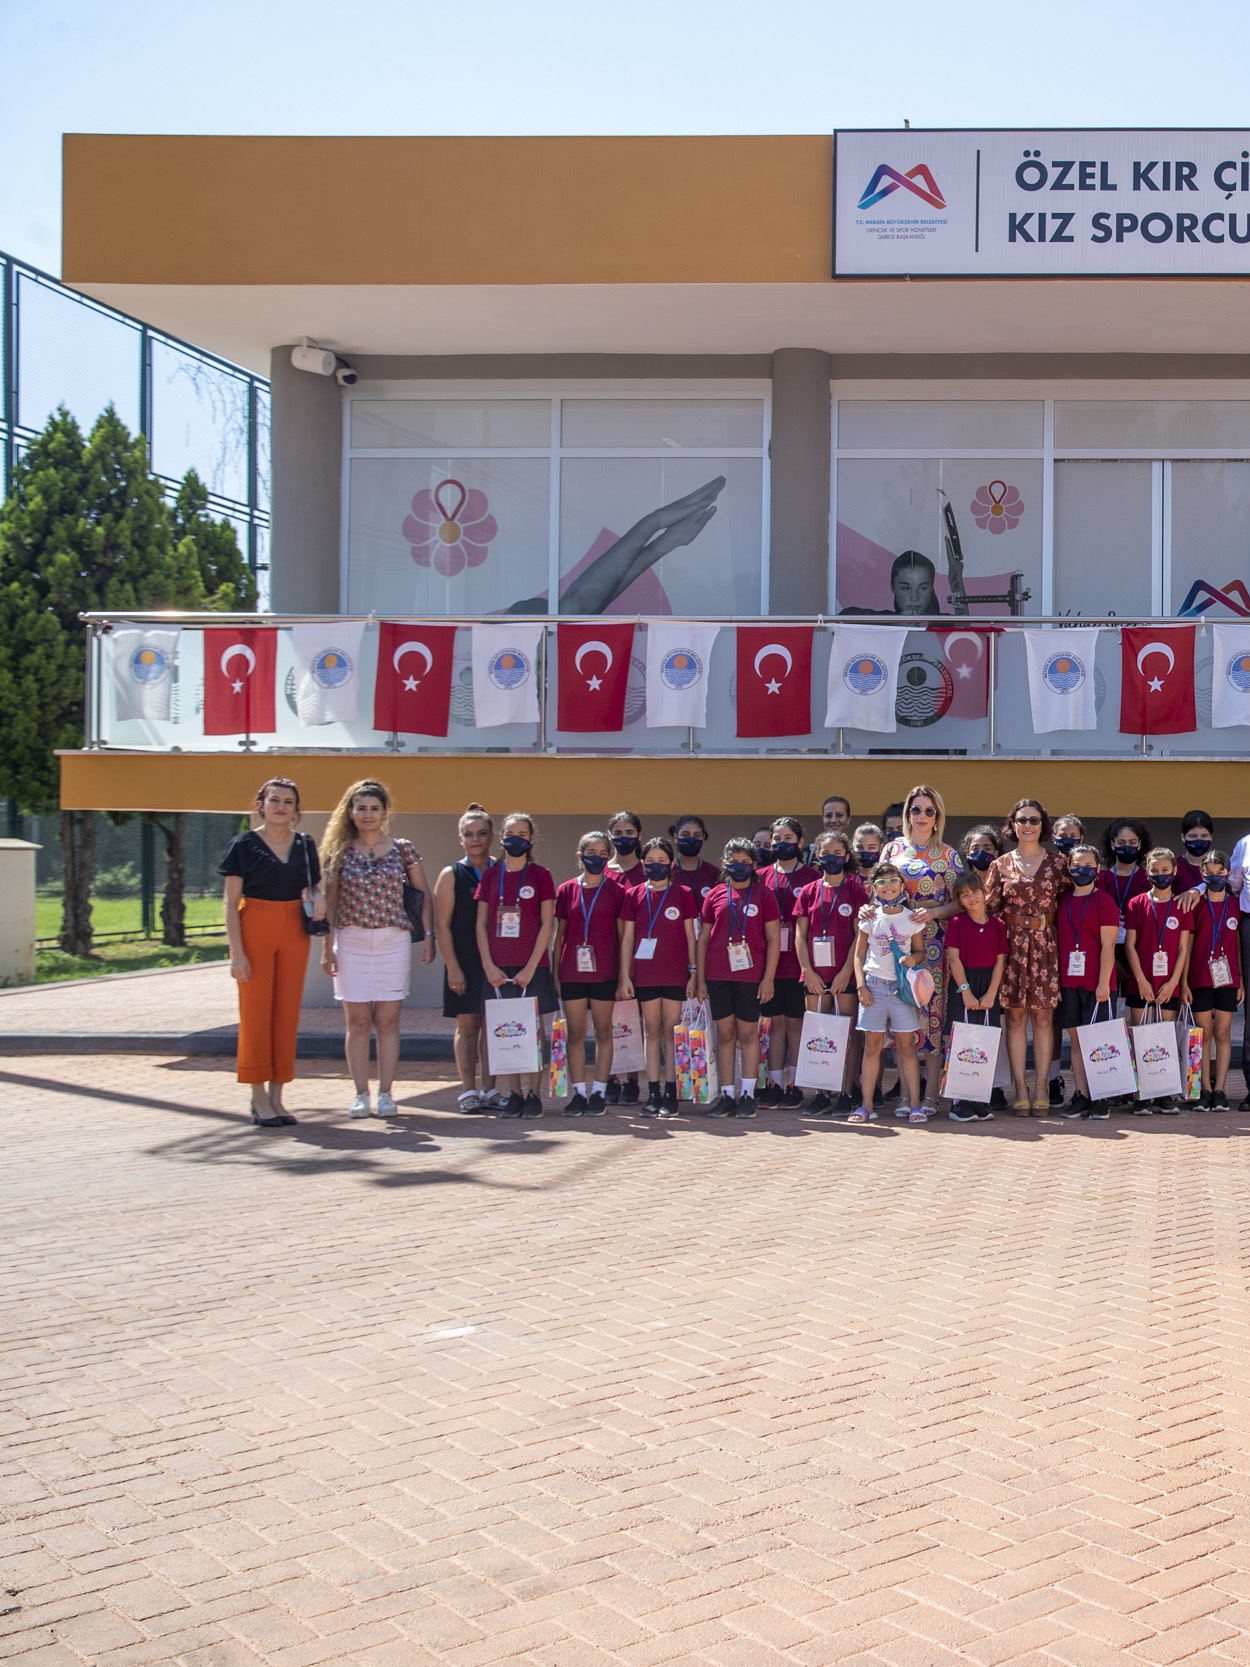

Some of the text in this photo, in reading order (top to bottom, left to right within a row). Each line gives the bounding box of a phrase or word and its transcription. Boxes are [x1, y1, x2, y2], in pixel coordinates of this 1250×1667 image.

[1016, 150, 1117, 191] ÖZEL
[1133, 162, 1199, 191] KIR
[1009, 213, 1075, 242] KIZ
